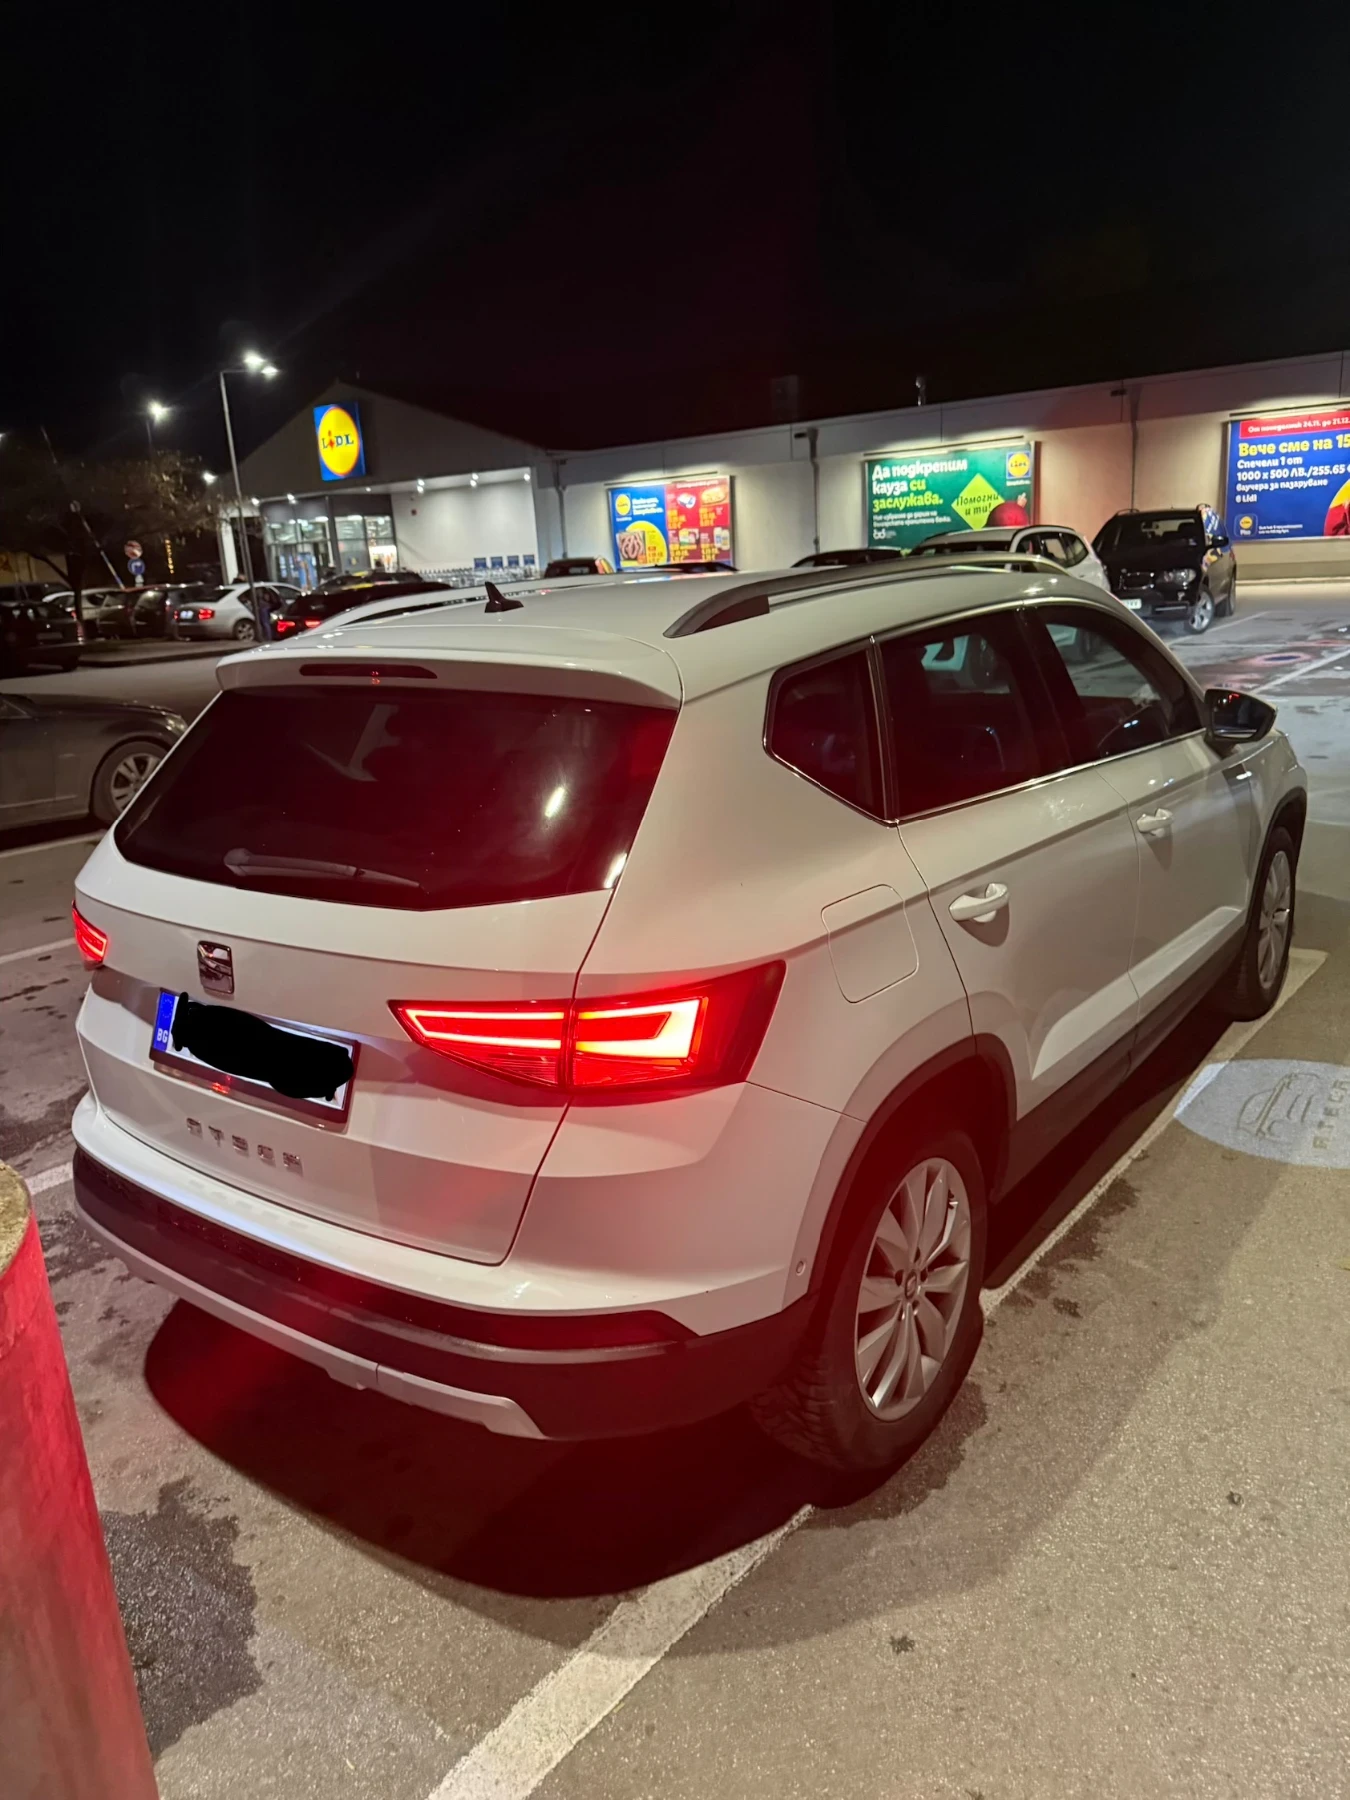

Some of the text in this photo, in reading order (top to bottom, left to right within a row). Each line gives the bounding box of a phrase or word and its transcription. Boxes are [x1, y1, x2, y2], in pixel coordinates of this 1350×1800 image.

[1238, 442, 1276, 457] Вече
[1279, 440, 1310, 453] сме
[1313, 438, 1333, 451] на
[872, 458, 968, 480] Да подкрепим
[1237, 458, 1279, 469] Спечели
[1286, 456, 1303, 465] от
[1236, 471, 1261, 481] 1000
[1269, 468, 1290, 479] 500
[872, 478, 926, 496] кауза си
[872, 491, 944, 513] заслужава.
[956, 494, 999, 506] Помогни
[973, 502, 991, 515] ти!
[157, 1028, 168, 1043] BG
